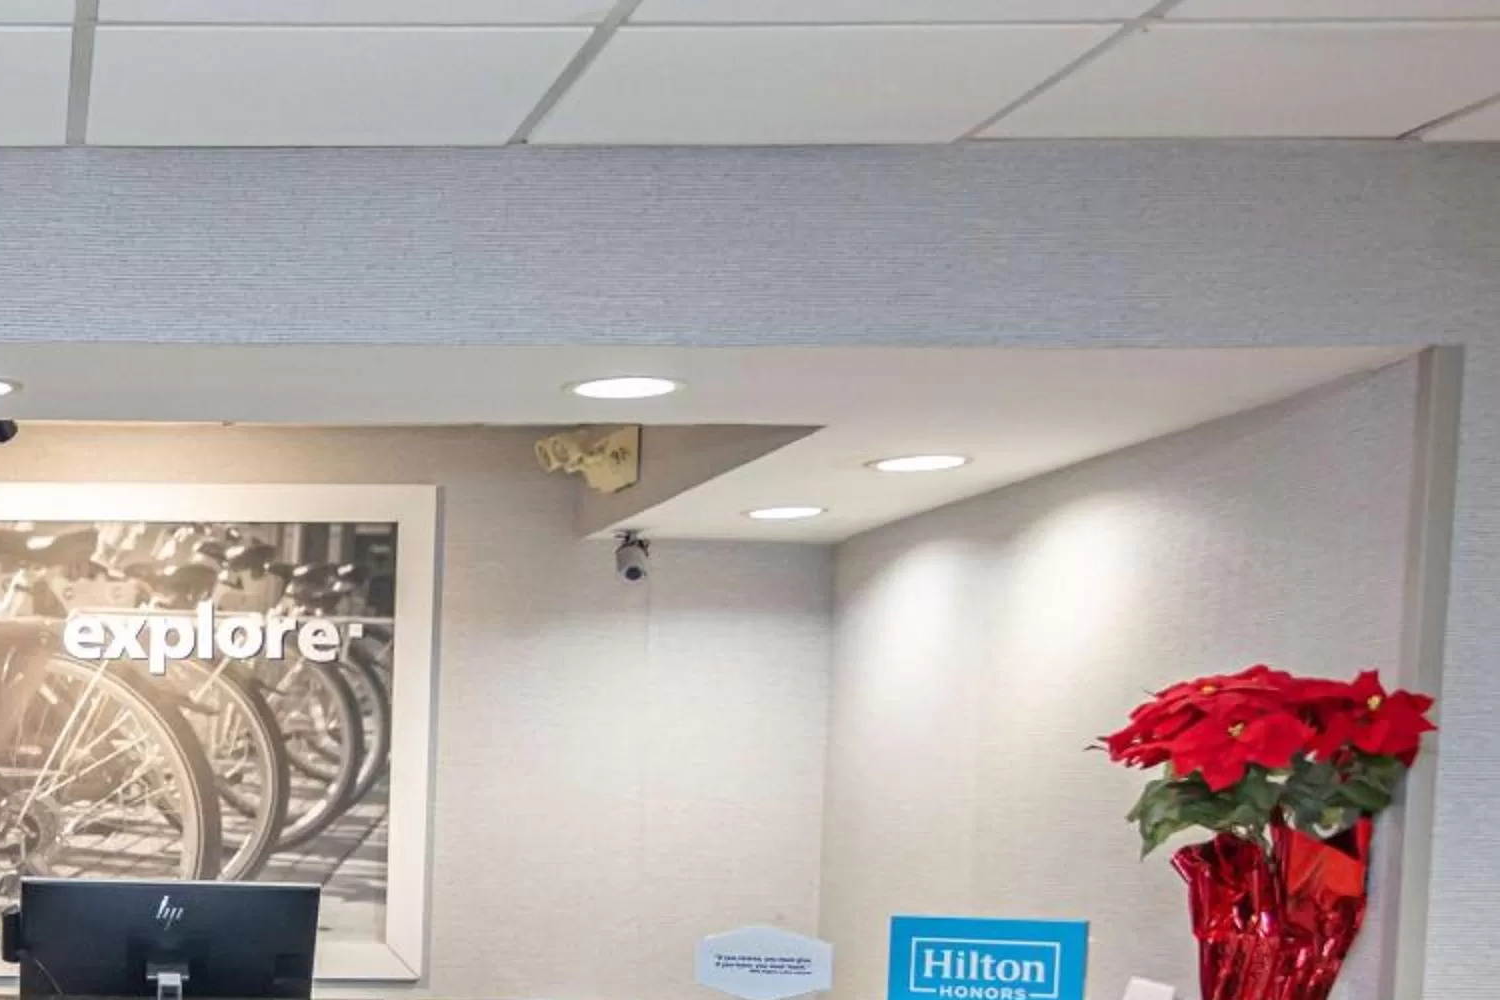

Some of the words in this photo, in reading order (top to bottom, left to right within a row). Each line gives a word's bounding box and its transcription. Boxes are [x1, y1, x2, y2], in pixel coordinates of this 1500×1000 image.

[63, 600, 342, 675] explore
[923, 949, 1046, 983] Hilton
[939, 985, 1027, 1000] HONORS
